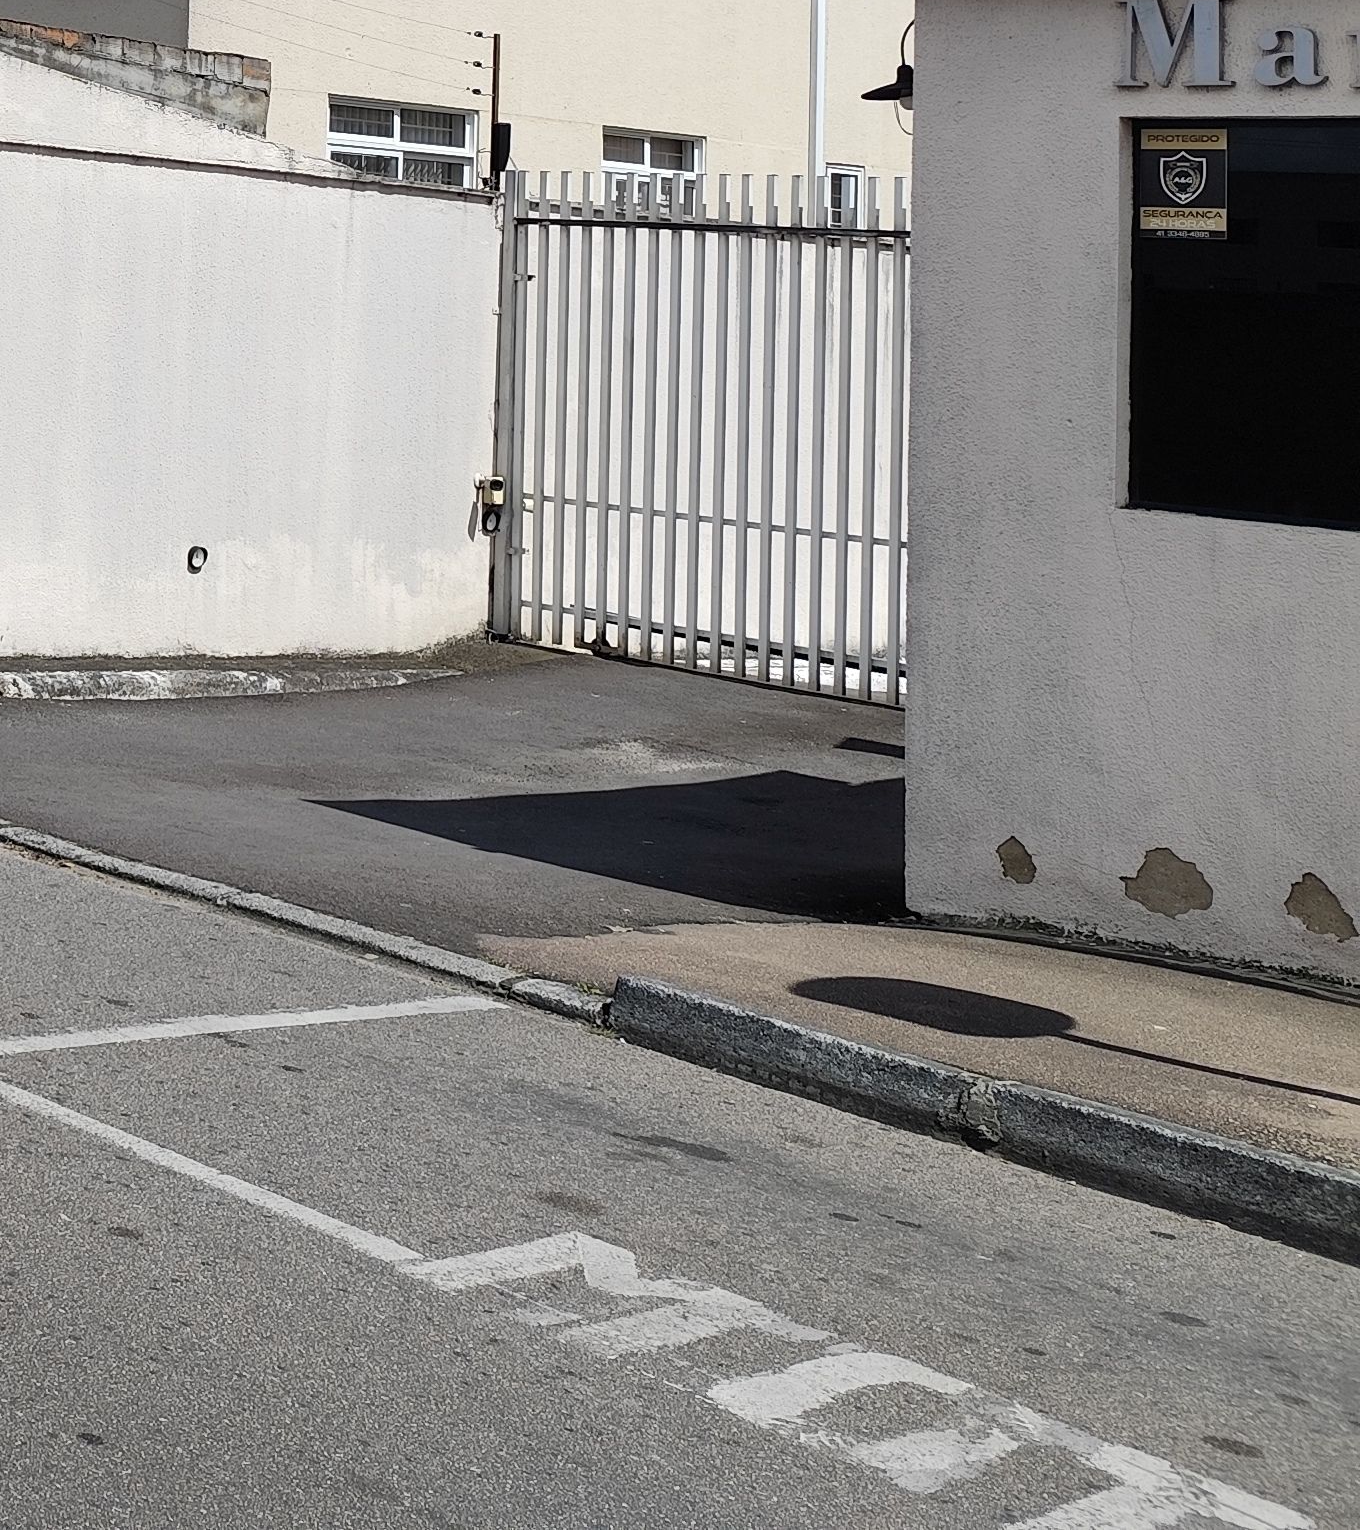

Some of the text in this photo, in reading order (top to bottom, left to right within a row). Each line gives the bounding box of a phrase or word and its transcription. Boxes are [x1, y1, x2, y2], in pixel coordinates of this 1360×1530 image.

[1147, 134, 1220, 143] PROTEGIDO
[1150, 219, 1216, 229] 24 HORAS
